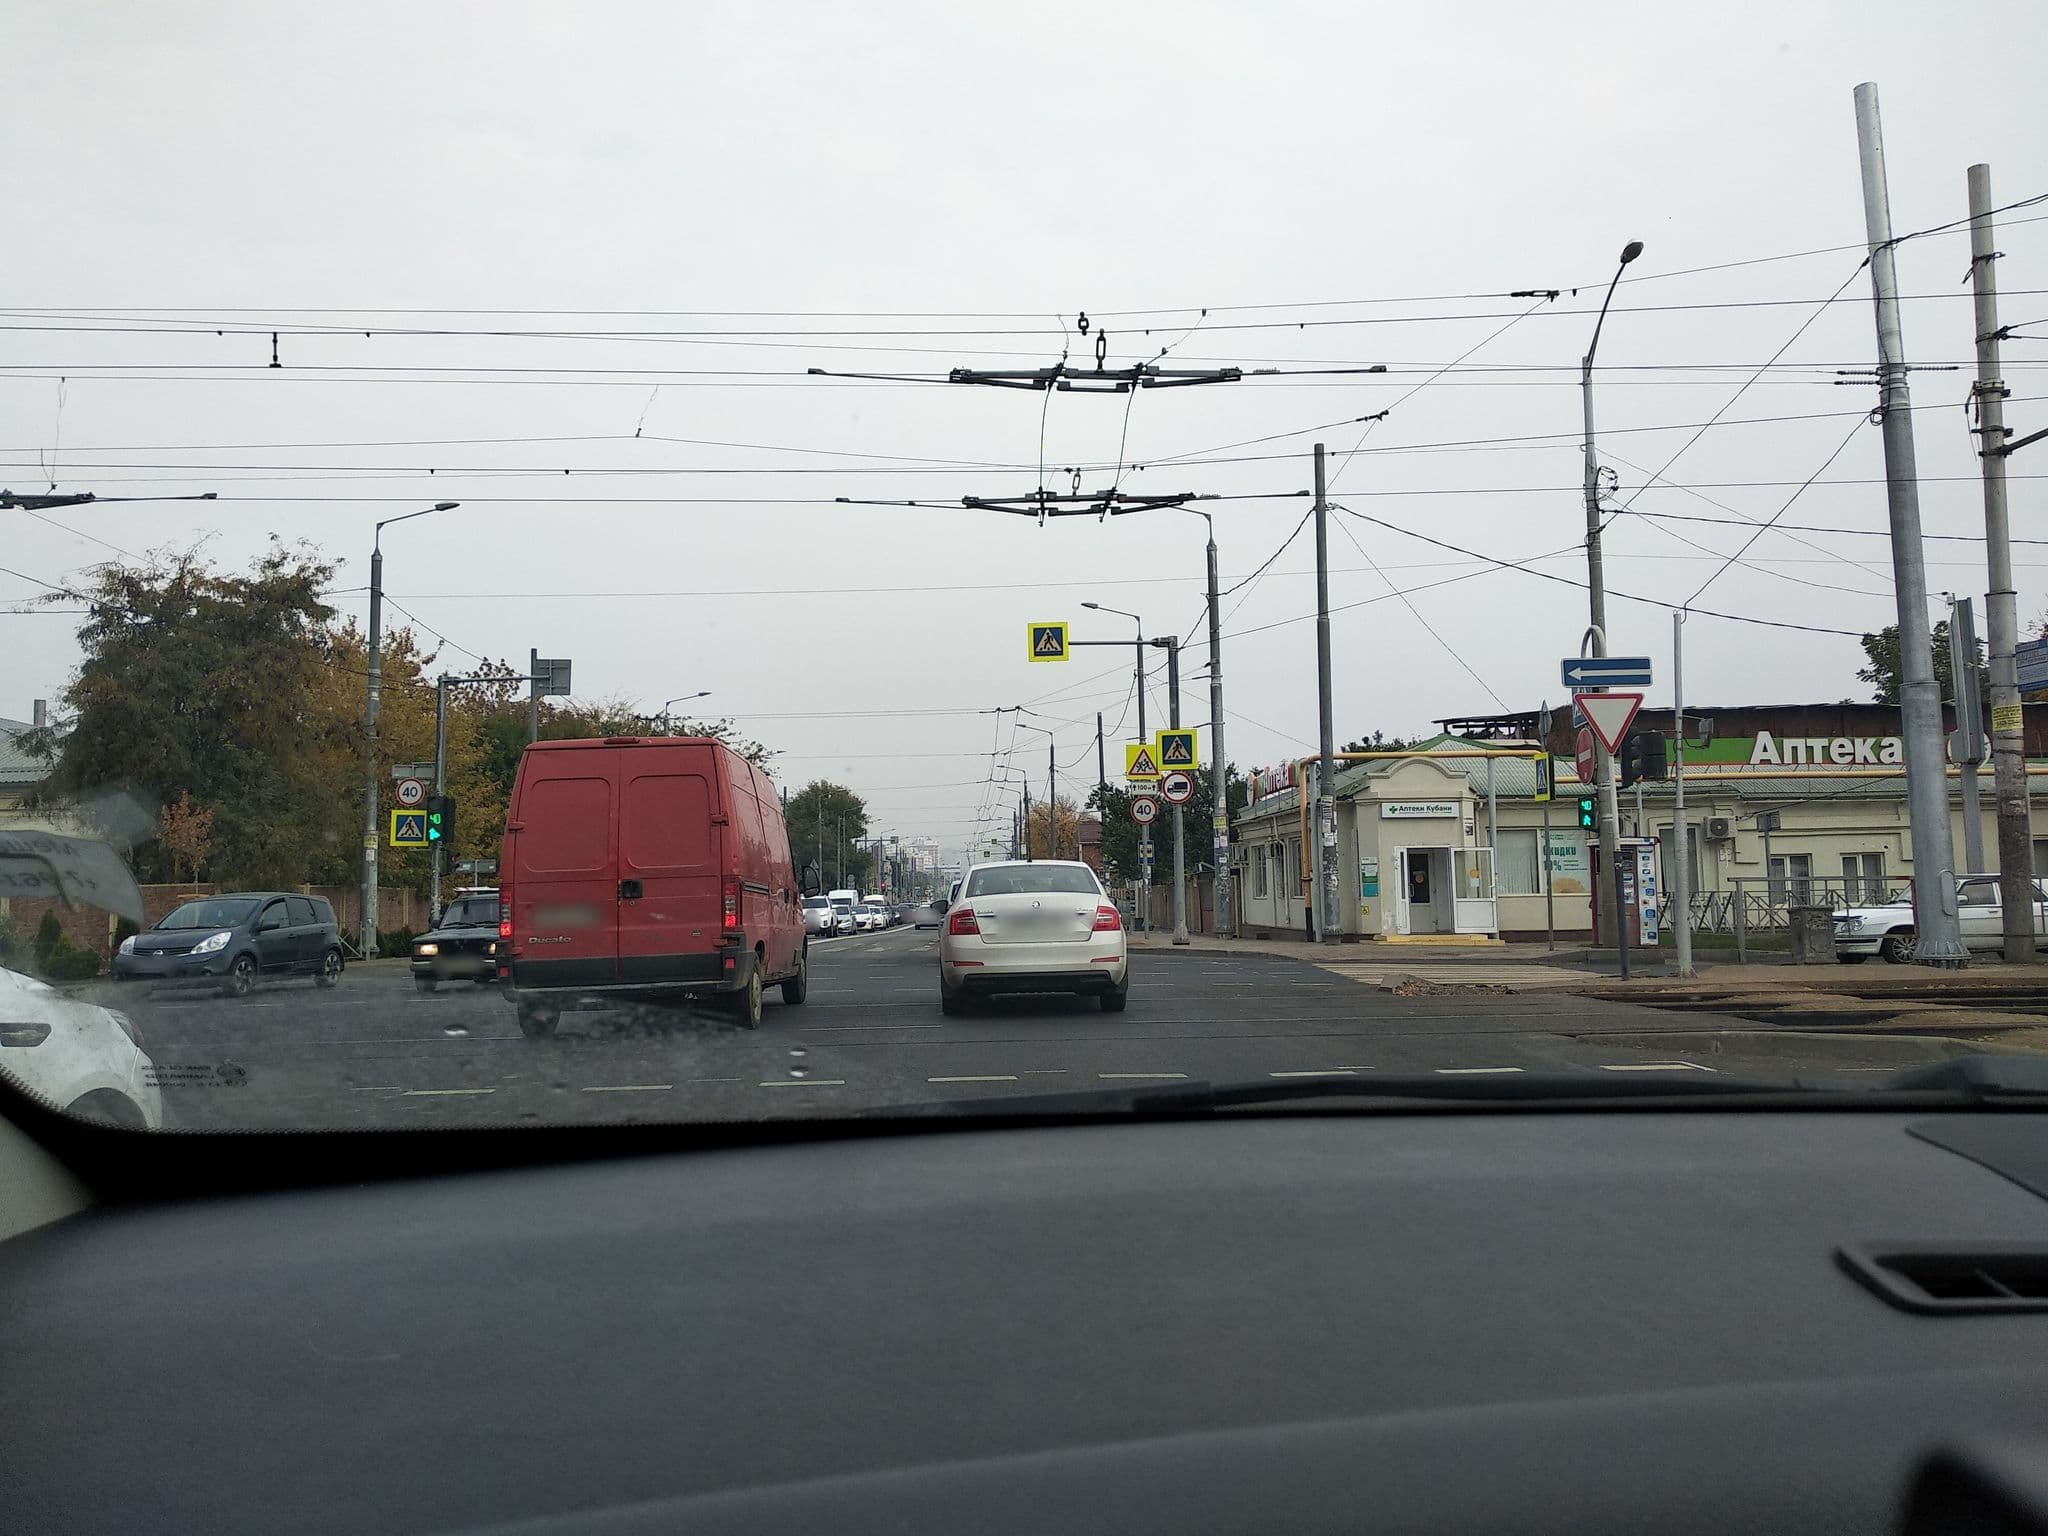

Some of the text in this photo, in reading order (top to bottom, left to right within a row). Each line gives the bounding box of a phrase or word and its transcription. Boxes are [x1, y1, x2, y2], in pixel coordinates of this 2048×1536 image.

[1749, 730, 1904, 765] Аптека
[402, 786, 418, 798] 40
[1136, 804, 1152, 816] 40
[1426, 804, 1452, 814] Кубани
[1581, 800, 1592, 811] 40
[528, 935, 573, 944] Ducato
